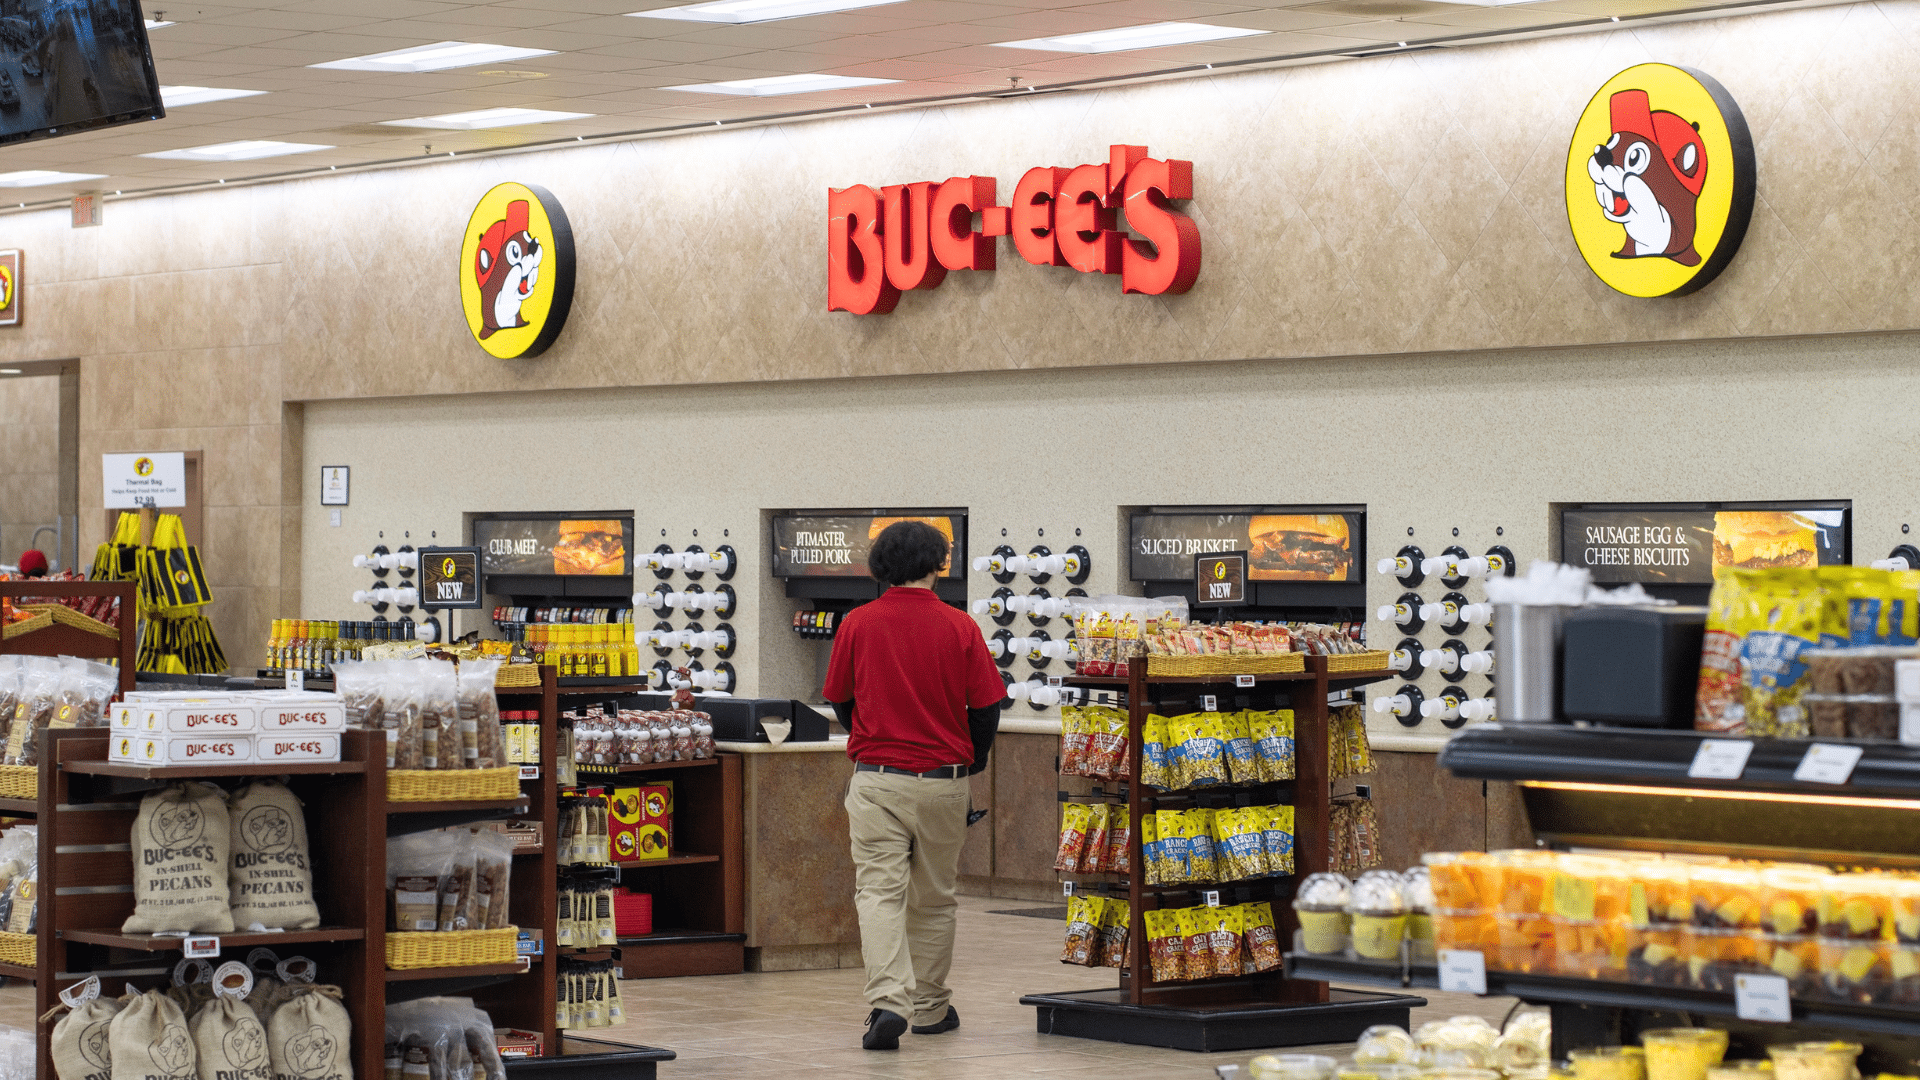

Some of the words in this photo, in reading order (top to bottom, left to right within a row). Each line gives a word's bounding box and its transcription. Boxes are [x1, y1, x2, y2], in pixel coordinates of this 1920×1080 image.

[828, 144, 1201, 315] BUC-EE'S
[796, 531, 847, 547] PITMASTER
[1586, 526, 1640, 544] SAUSAGE
[1644, 526, 1672, 544] EGG
[1675, 526, 1688, 544] &
[489, 538, 512, 555] CLUB
[514, 538, 538, 555] MELT
[1140, 538, 1183, 555] SLICED
[1185, 538, 1239, 555] BRISKET
[790, 549, 823, 564] PULLED
[825, 549, 852, 564] PORK
[1584, 547, 1630, 565] CHEESE
[1633, 547, 1690, 566] BISCUITS
[436, 581, 464, 600] NEW
[1209, 582, 1232, 599] NEW
[186, 713, 238, 727] BUC-EE'S
[279, 711, 327, 726] BUC-EE'S
[186, 742, 235, 757] BUC-EE'S
[274, 741, 322, 756] BUC-EE'S
[143, 843, 214, 866] BUC-EE'S
[156, 862, 203, 875] IN-SHELL
[249, 869, 296, 879] IN-SHELL
[150, 875, 213, 892] PECANS
[240, 880, 304, 896] PECANS
